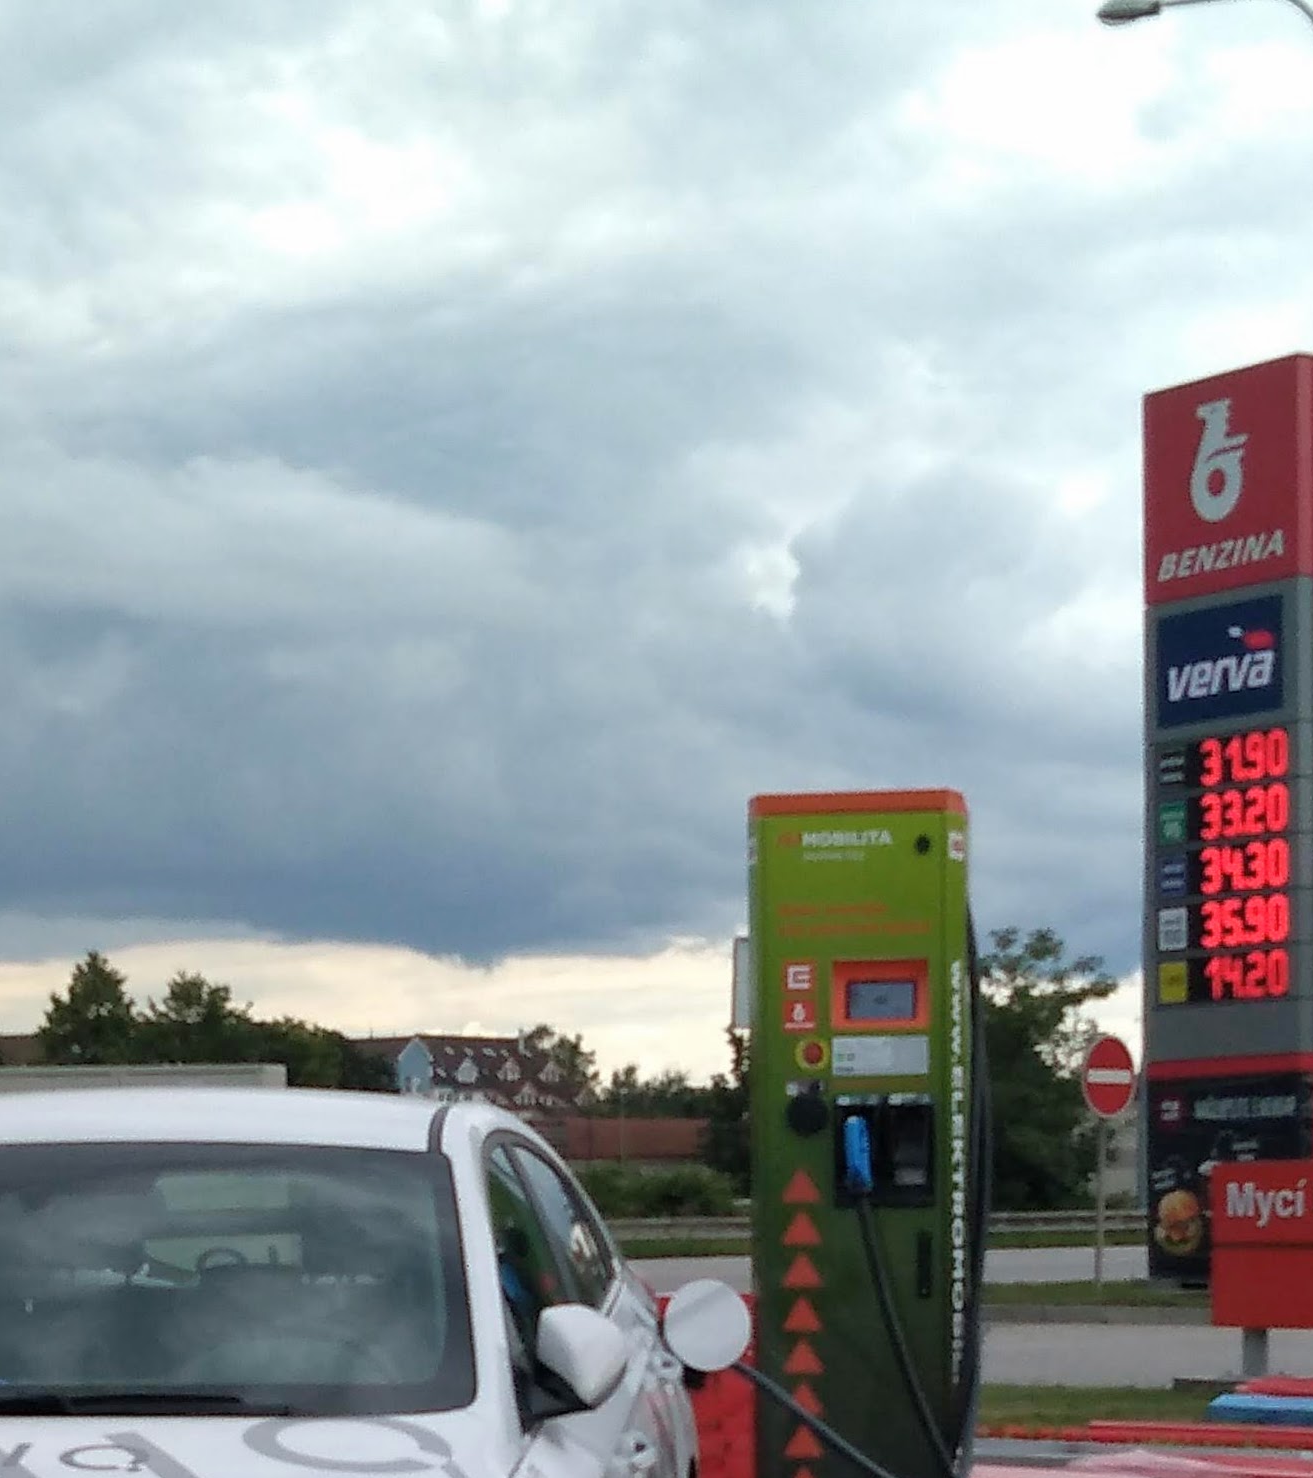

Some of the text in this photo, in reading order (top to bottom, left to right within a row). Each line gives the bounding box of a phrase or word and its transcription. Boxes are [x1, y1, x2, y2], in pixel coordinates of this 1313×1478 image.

[1157, 529, 1285, 582] BENZINA
[1168, 649, 1276, 703] verva
[1226, 1178, 1307, 1228] Mycí
